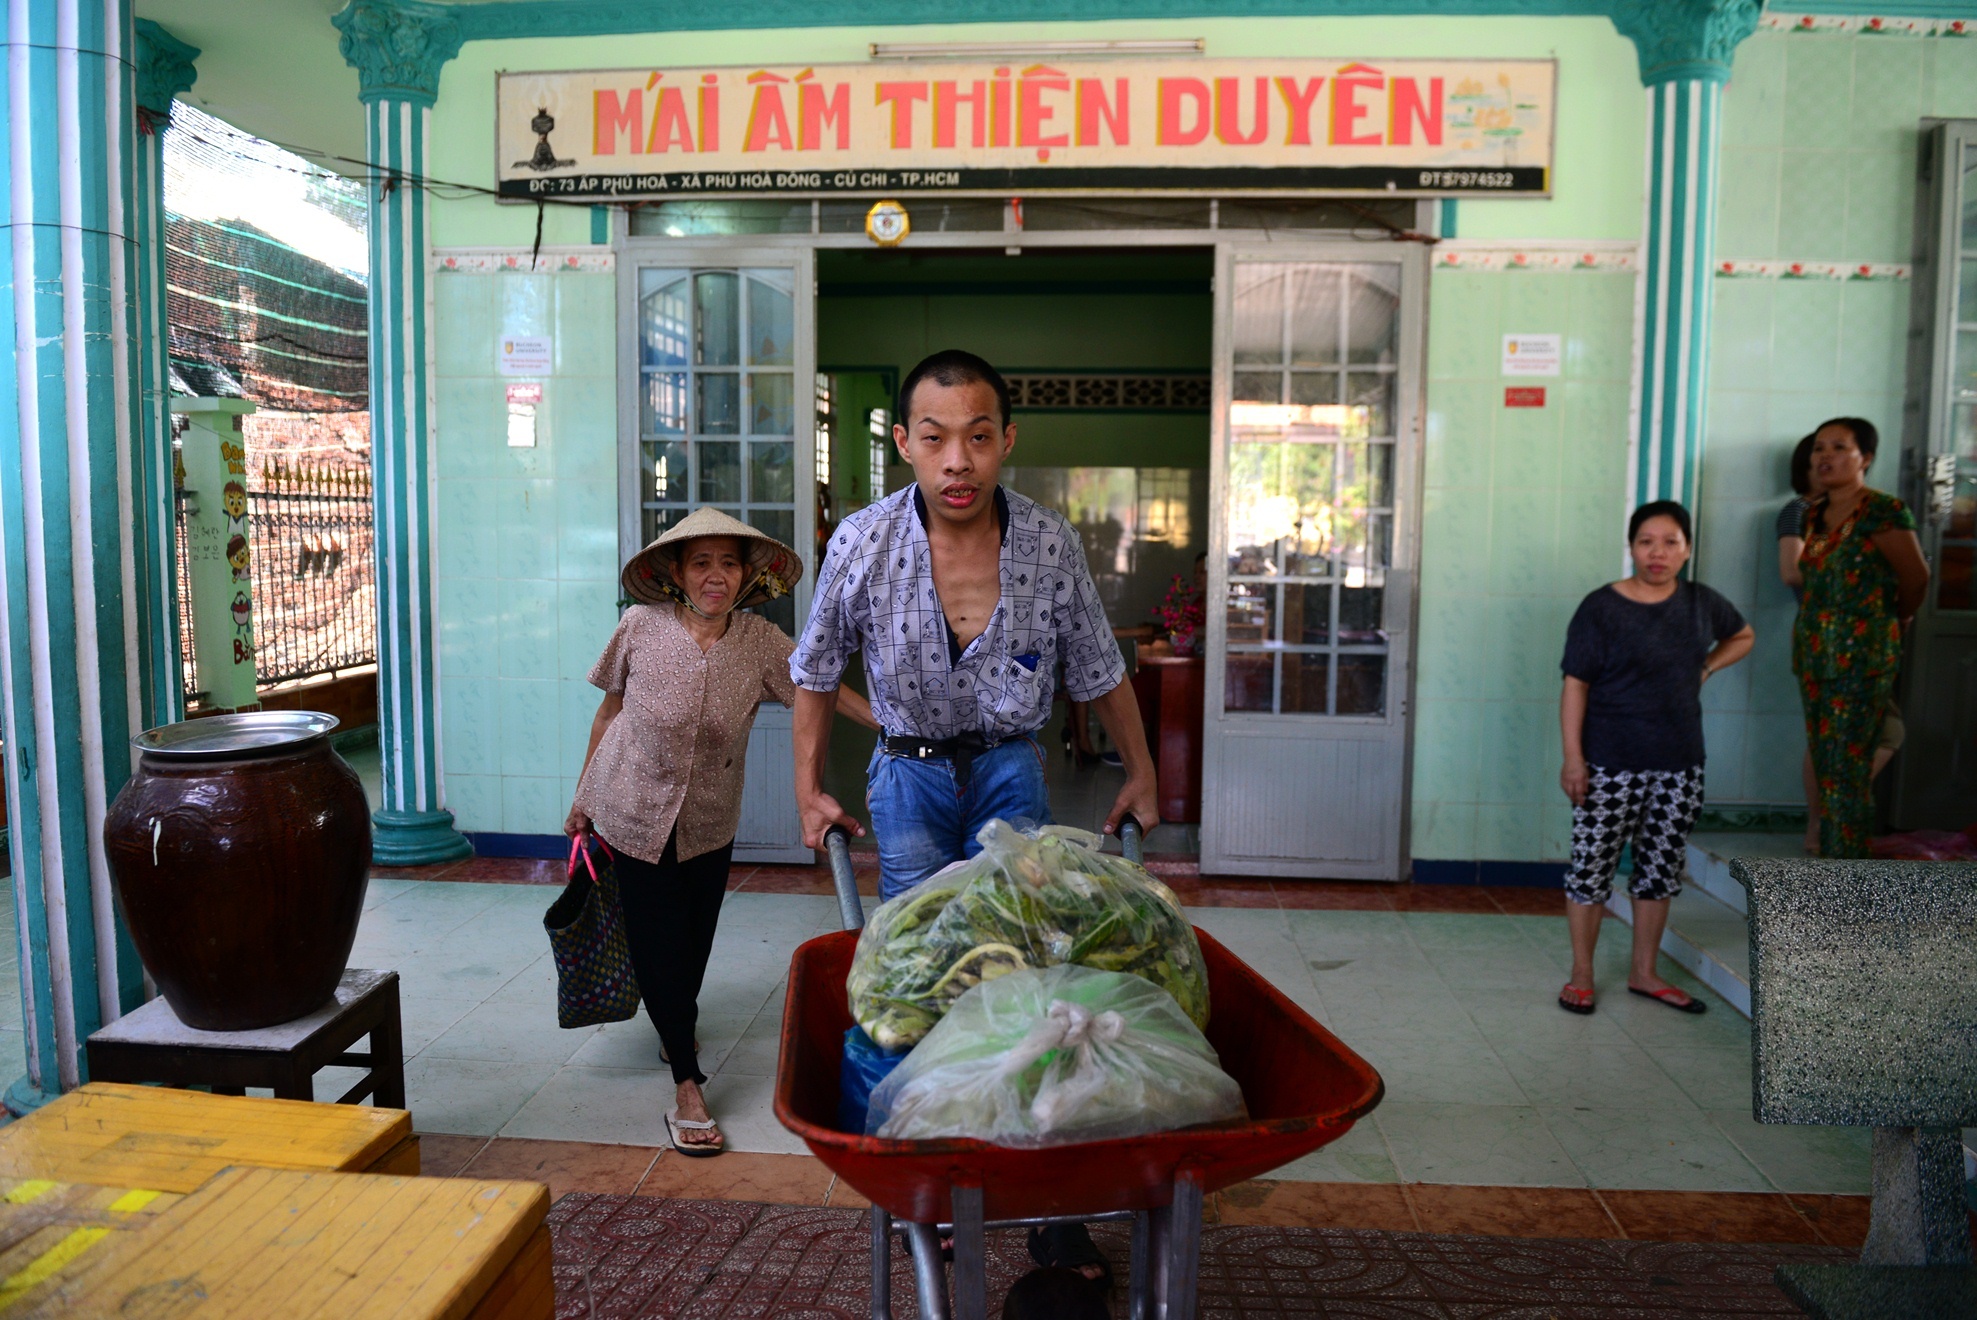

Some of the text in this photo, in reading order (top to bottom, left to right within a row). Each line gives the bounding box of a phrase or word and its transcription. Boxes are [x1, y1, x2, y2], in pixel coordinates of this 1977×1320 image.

[741, 67, 850, 154] ẤM
[1156, 62, 1444, 146] DUYÊN
[559, 178, 576, 192] 73
[860, 171, 888, 187] CHI
[900, 171, 960, 187] TP.HCM
